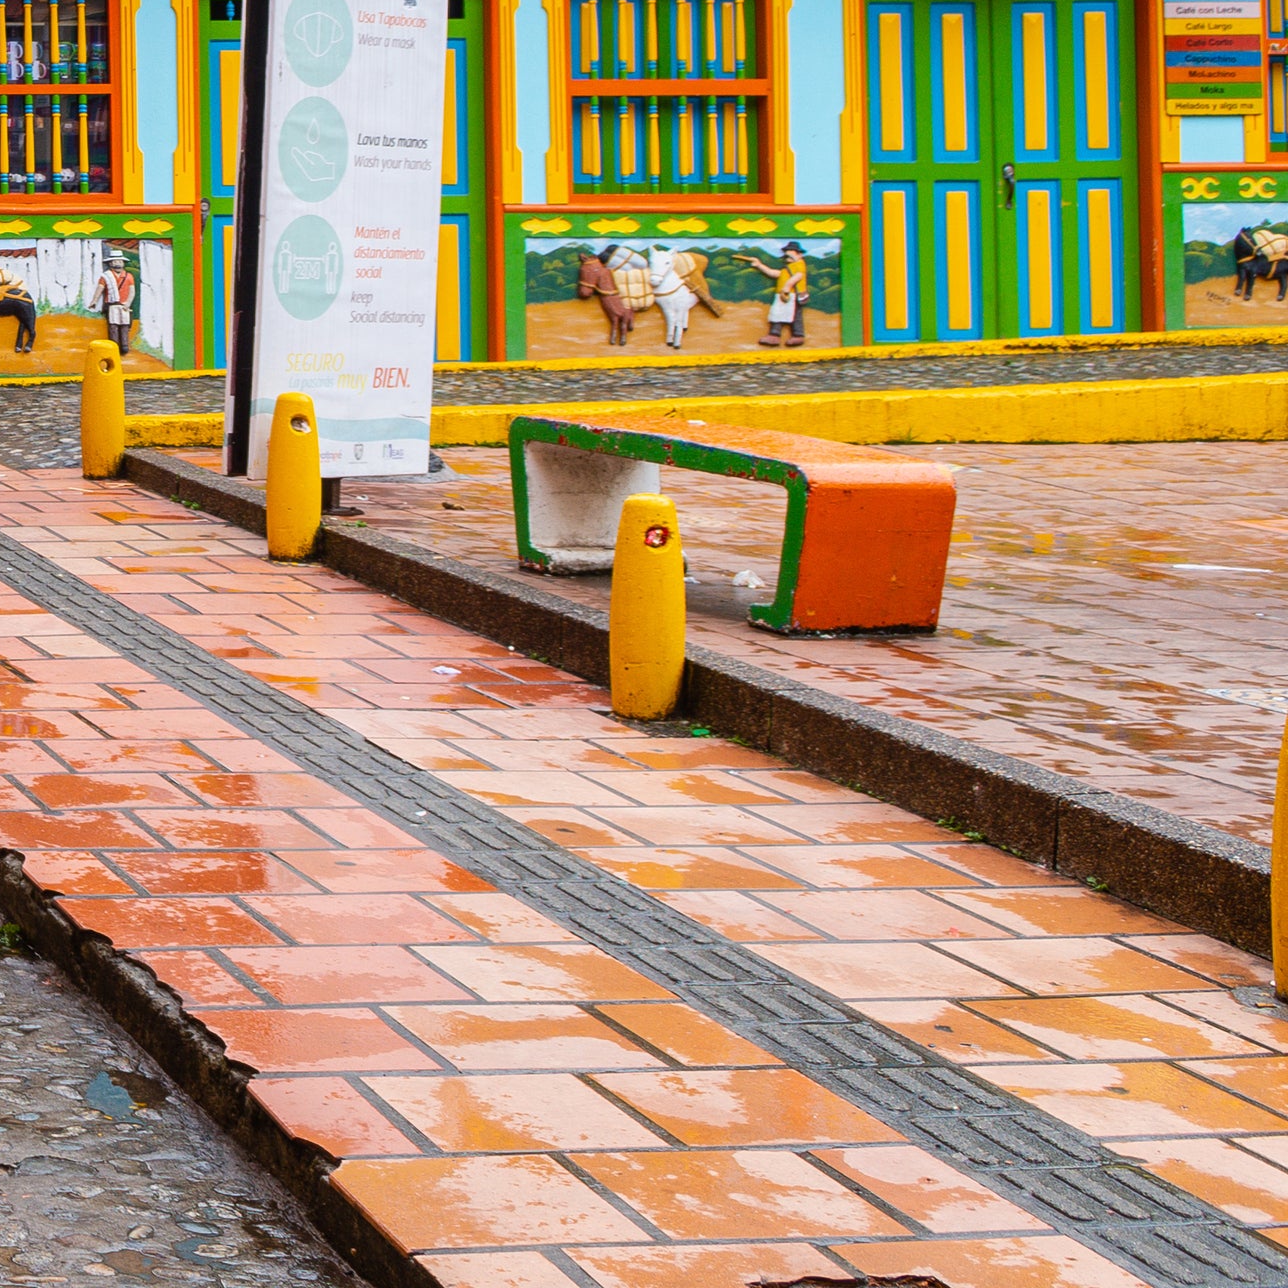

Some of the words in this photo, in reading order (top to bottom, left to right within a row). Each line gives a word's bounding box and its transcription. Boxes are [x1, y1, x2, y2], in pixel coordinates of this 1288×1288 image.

[1216, 6, 1242, 14] Leche
[357, 10, 376, 24] Usa
[378, 11, 428, 29] Tapabocas
[1207, 23, 1233, 32] Largo
[357, 32, 383, 47] Wear
[391, 36, 416, 50] mask
[1200, 86, 1224, 94] Moka
[357, 133, 381, 146] Lava
[382, 134, 396, 148] tus
[397, 137, 428, 149] manos
[354, 155, 380, 168] Wash
[381, 158, 403, 173] your
[403, 157, 433, 171] hands
[354, 225, 390, 240] Mantén
[391, 227, 401, 240] el
[354, 246, 426, 260] distanciamiento
[294, 261, 322, 280] 2M
[355, 266, 383, 279] social
[350, 291, 374, 307] keep
[349, 310, 378, 324] Social
[379, 310, 426, 327] distancing
[286, 352, 345, 373] SEGURO
[337, 372, 368, 396] muy
[372, 366, 411, 389] BIEN.
